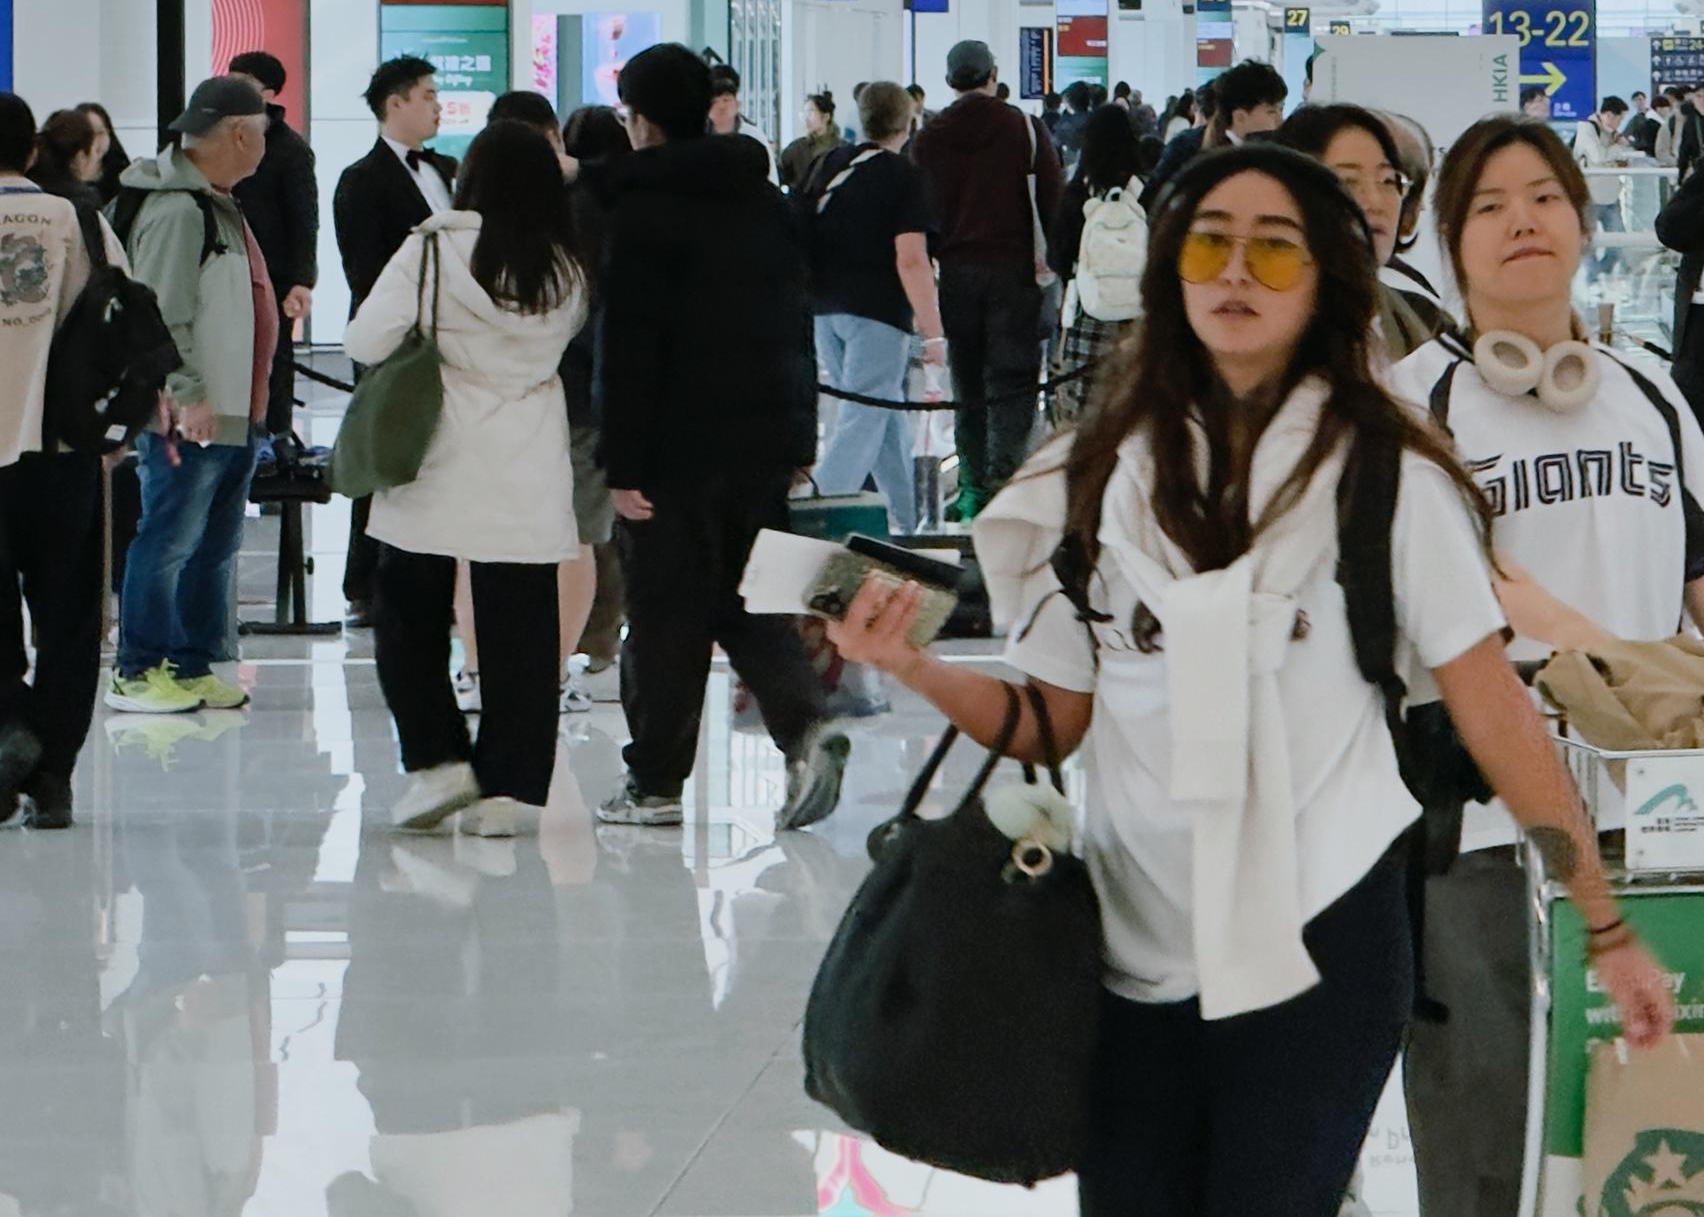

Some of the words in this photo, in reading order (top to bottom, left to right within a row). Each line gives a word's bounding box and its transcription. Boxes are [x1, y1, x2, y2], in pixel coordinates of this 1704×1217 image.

[1287, 9, 1308, 27] 27
[1488, 9, 1591, 48] 13-22
[1492, 53, 1508, 103] HKIA
